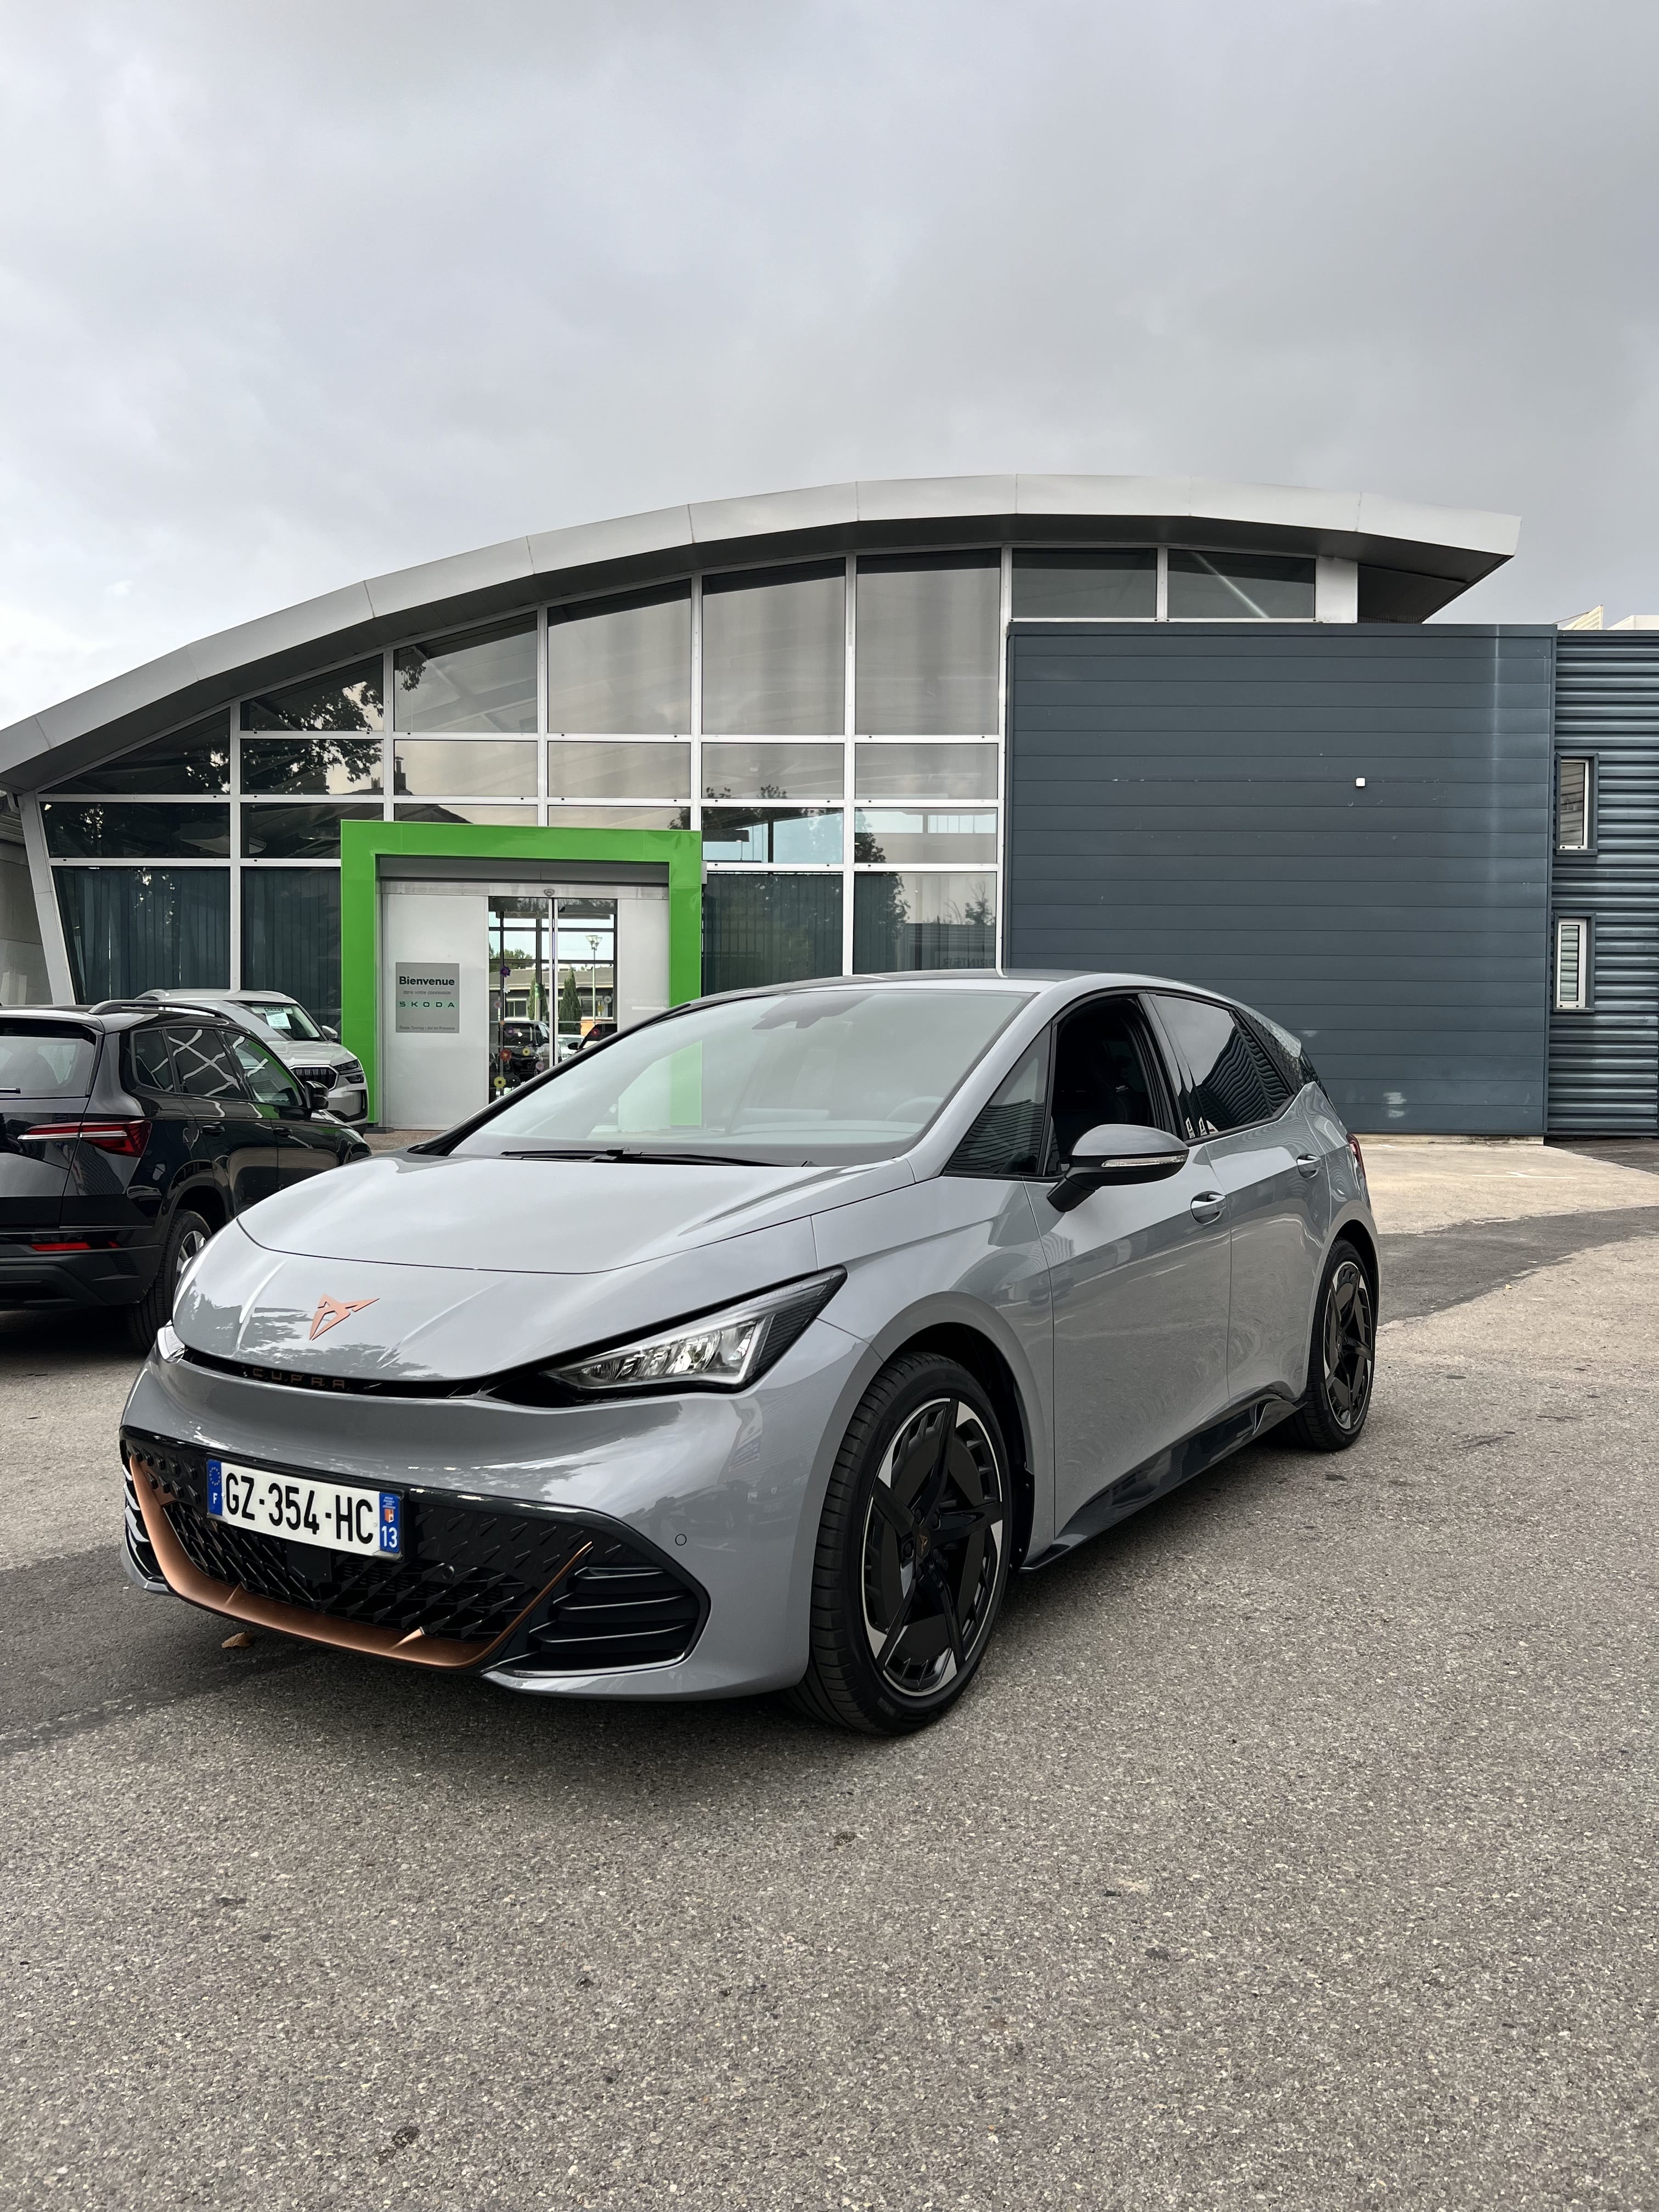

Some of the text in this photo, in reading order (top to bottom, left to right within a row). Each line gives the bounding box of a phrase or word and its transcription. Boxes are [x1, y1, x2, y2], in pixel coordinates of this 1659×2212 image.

[399, 976, 455, 985] Bienvenue
[252, 1367, 345, 1389] CUPRA
[213, 1492, 217, 1504] F
[225, 1472, 373, 1544] GZ-354-HC
[381, 1526, 398, 1548] 13
